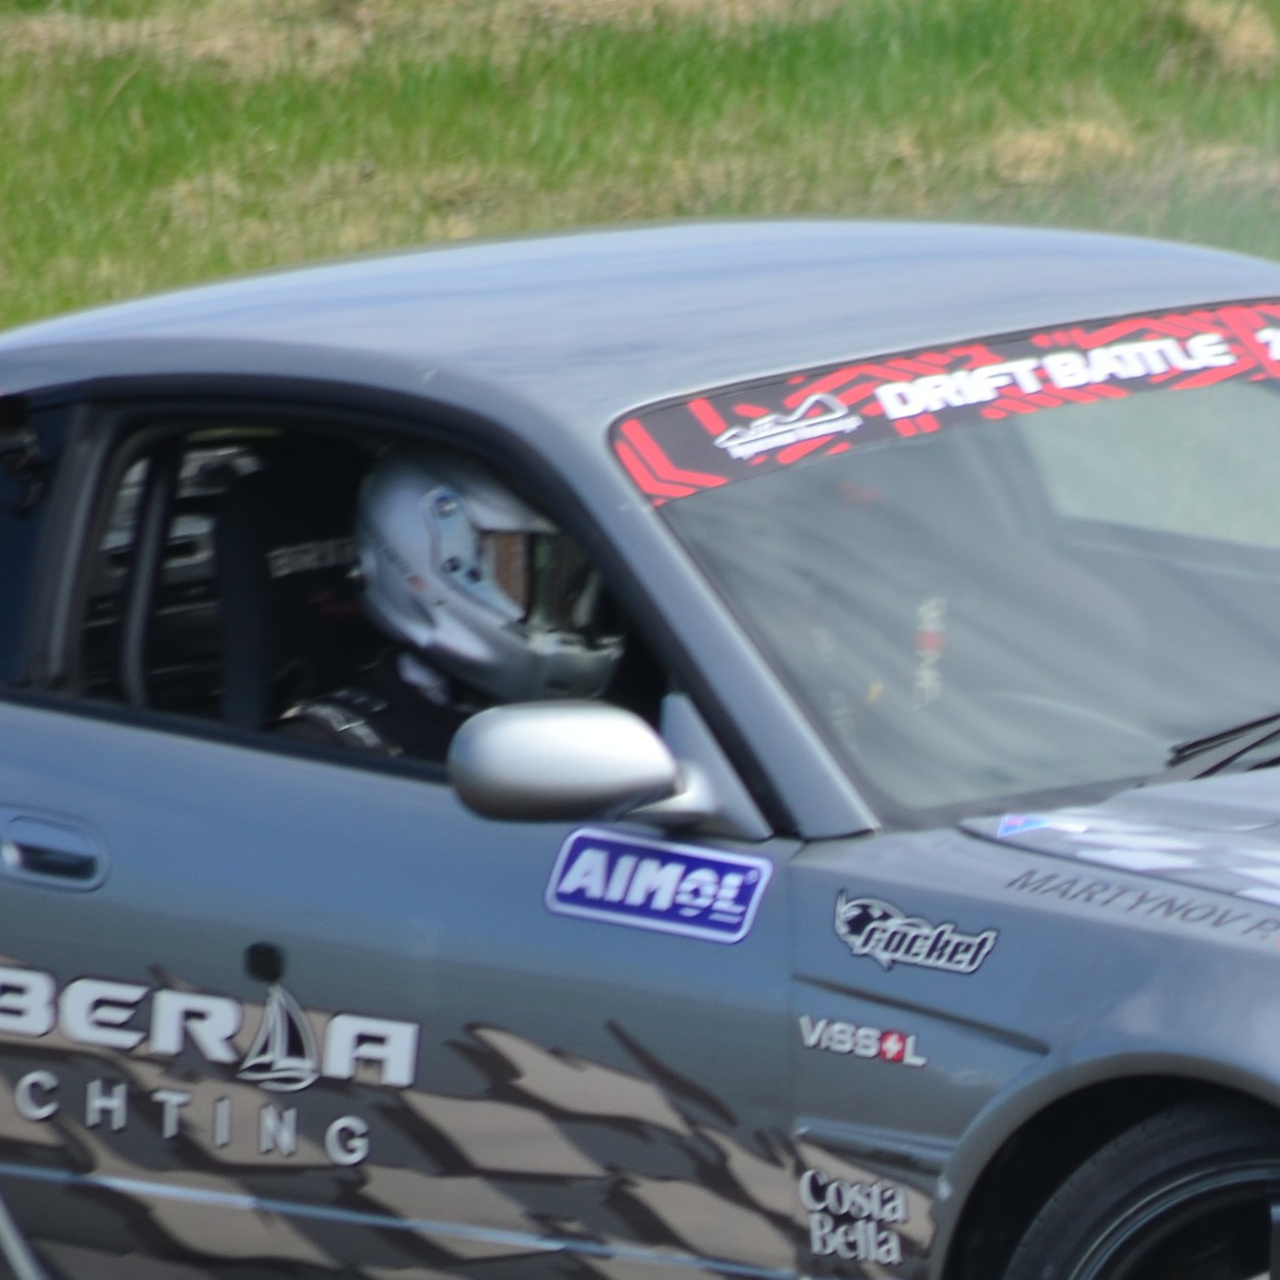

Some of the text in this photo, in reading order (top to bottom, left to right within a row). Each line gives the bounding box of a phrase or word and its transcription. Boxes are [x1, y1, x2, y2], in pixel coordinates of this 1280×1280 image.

[873, 357, 1044, 421] DRIFT
[1042, 332, 1238, 390] BATTLE
[556, 847, 746, 923] AIMOL
[1006, 868, 1242, 929] MARTYNOV
[14, 1069, 370, 1166] CHTING
[799, 1168, 907, 1224] Costa
[809, 1211, 902, 1266] Bella
